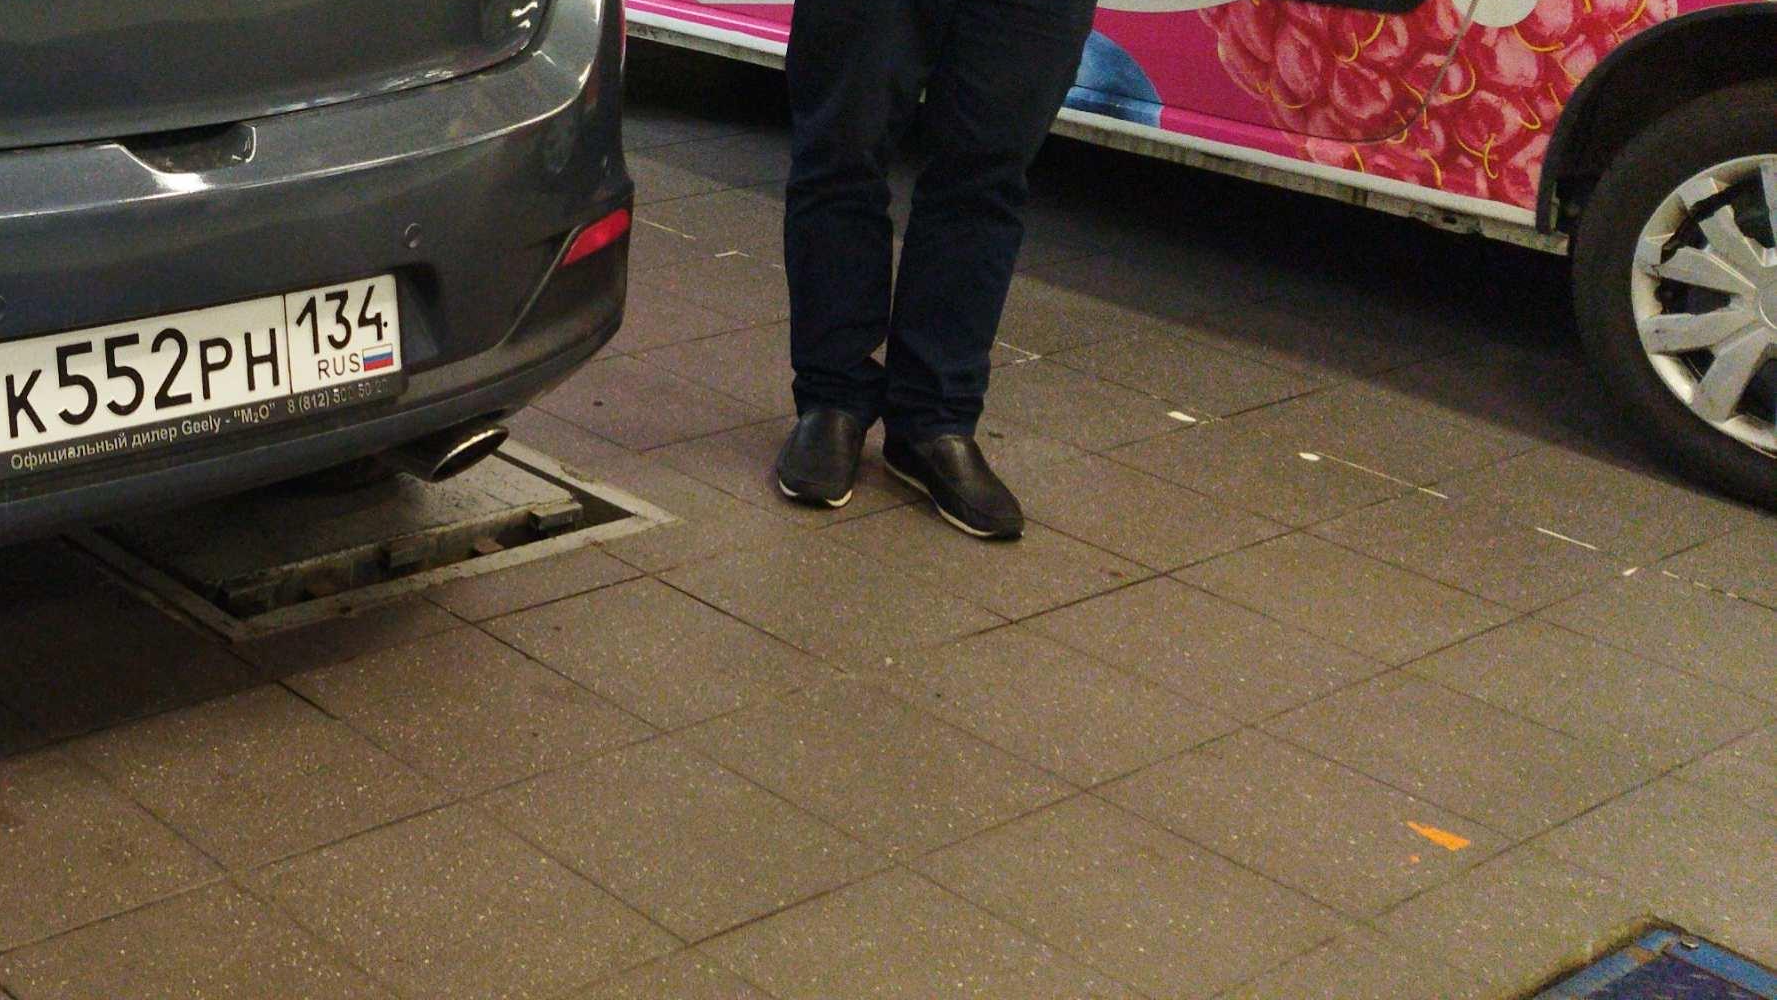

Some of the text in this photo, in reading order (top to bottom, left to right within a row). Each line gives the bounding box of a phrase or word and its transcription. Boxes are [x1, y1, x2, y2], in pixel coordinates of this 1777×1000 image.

[296, 284, 383, 355] 134
[4, 327, 280, 438] К552РН
[318, 352, 360, 379] RUS
[10, 431, 128, 472] Официальный
[132, 425, 177, 449] дилер
[181, 415, 221, 436] Geely
[299, 389, 330, 413] (812)
